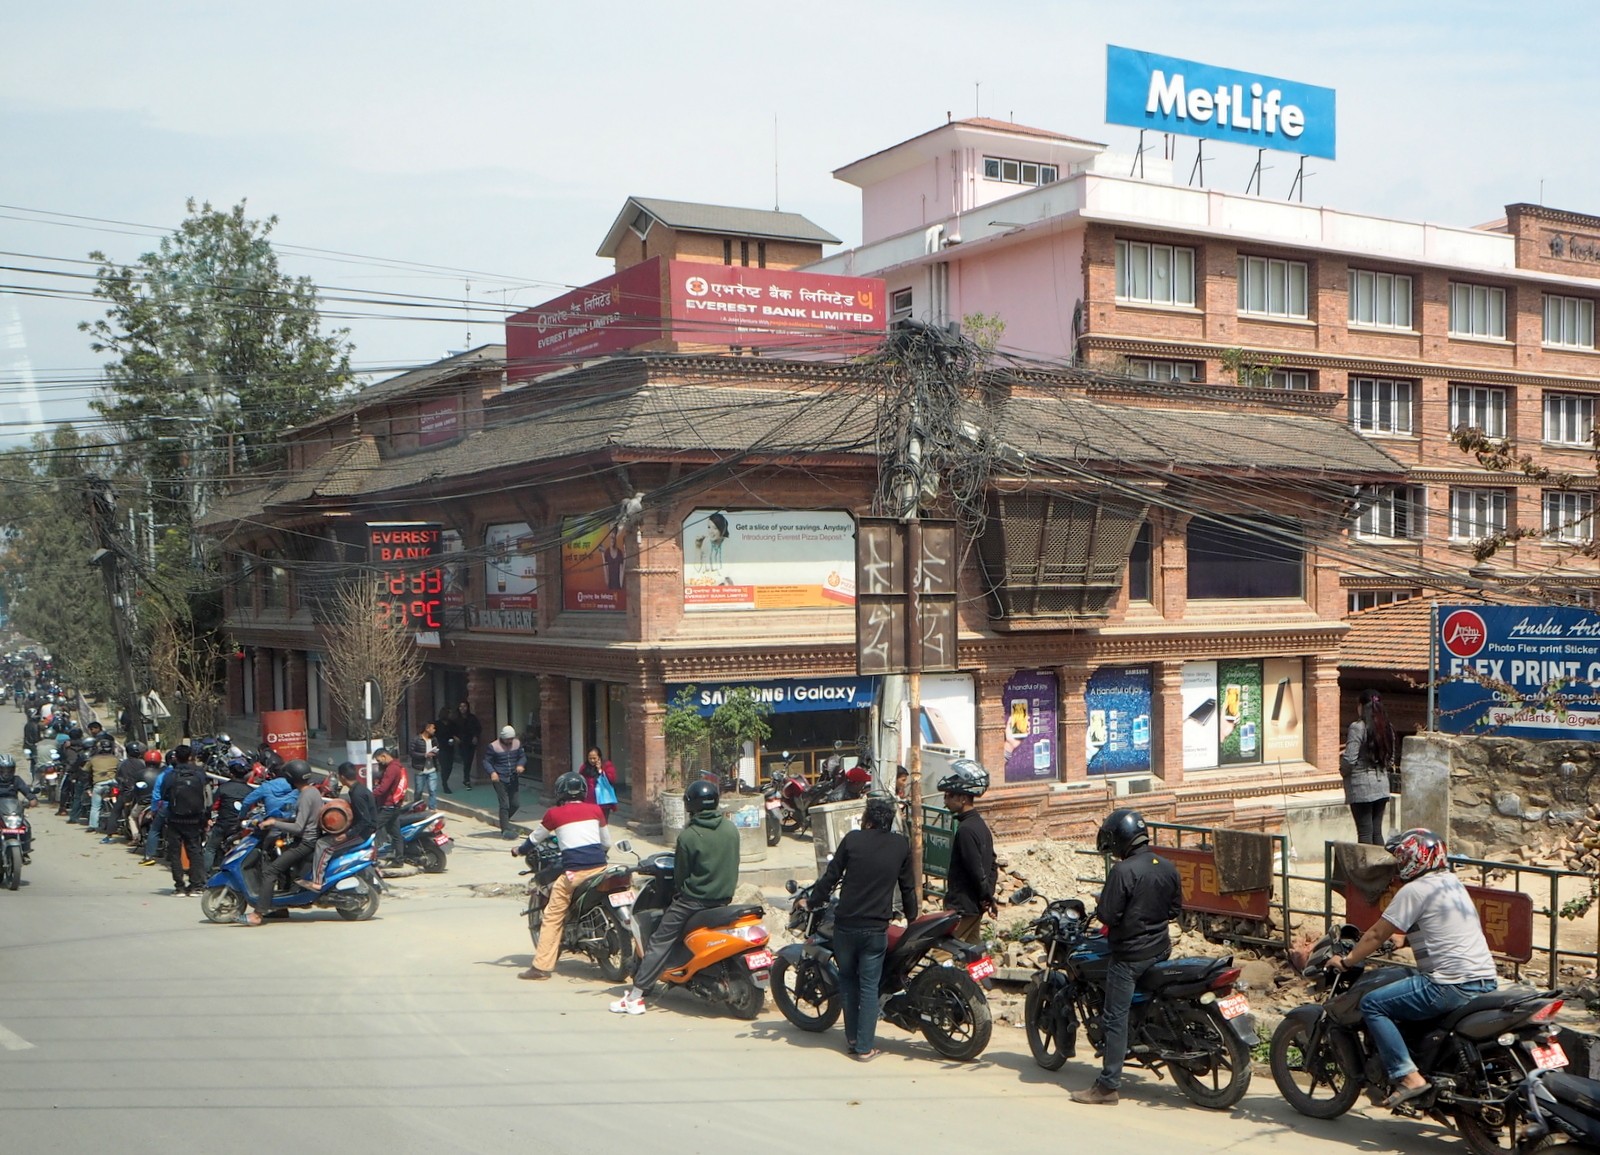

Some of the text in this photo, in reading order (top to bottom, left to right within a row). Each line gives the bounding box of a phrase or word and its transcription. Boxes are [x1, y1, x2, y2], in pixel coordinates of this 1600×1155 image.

[1145, 69, 1305, 138] MetLife
[769, 285, 793, 300] बैंक
[799, 287, 855, 307] लिमिटेड
[686, 299, 874, 323] EVEREST BANK LIMITED
[538, 330, 567, 349] EVEREST
[568, 324, 588, 338] BANK
[372, 530, 439, 544] EVEREST
[735, 523, 748, 531] Get
[754, 523, 769, 531] slice
[770, 523, 778, 531] of
[779, 524, 794, 532] your
[795, 523, 821, 532] savings.
[741, 533, 776, 542] Introducing
[777, 533, 801, 541] Everest
[801, 533, 818, 541] Pizza
[381, 547, 432, 560] BANK
[1509, 616, 1563, 637] Anshu
[1488, 643, 1598, 655] Photo Flex print Sticker
[1450, 658, 1504, 686] FLEX
[1510, 660, 1581, 688] PRINT
[793, 684, 857, 703] Galaxy
[1091, 687, 1096, 695] A
[1097, 686, 1124, 695] handful
